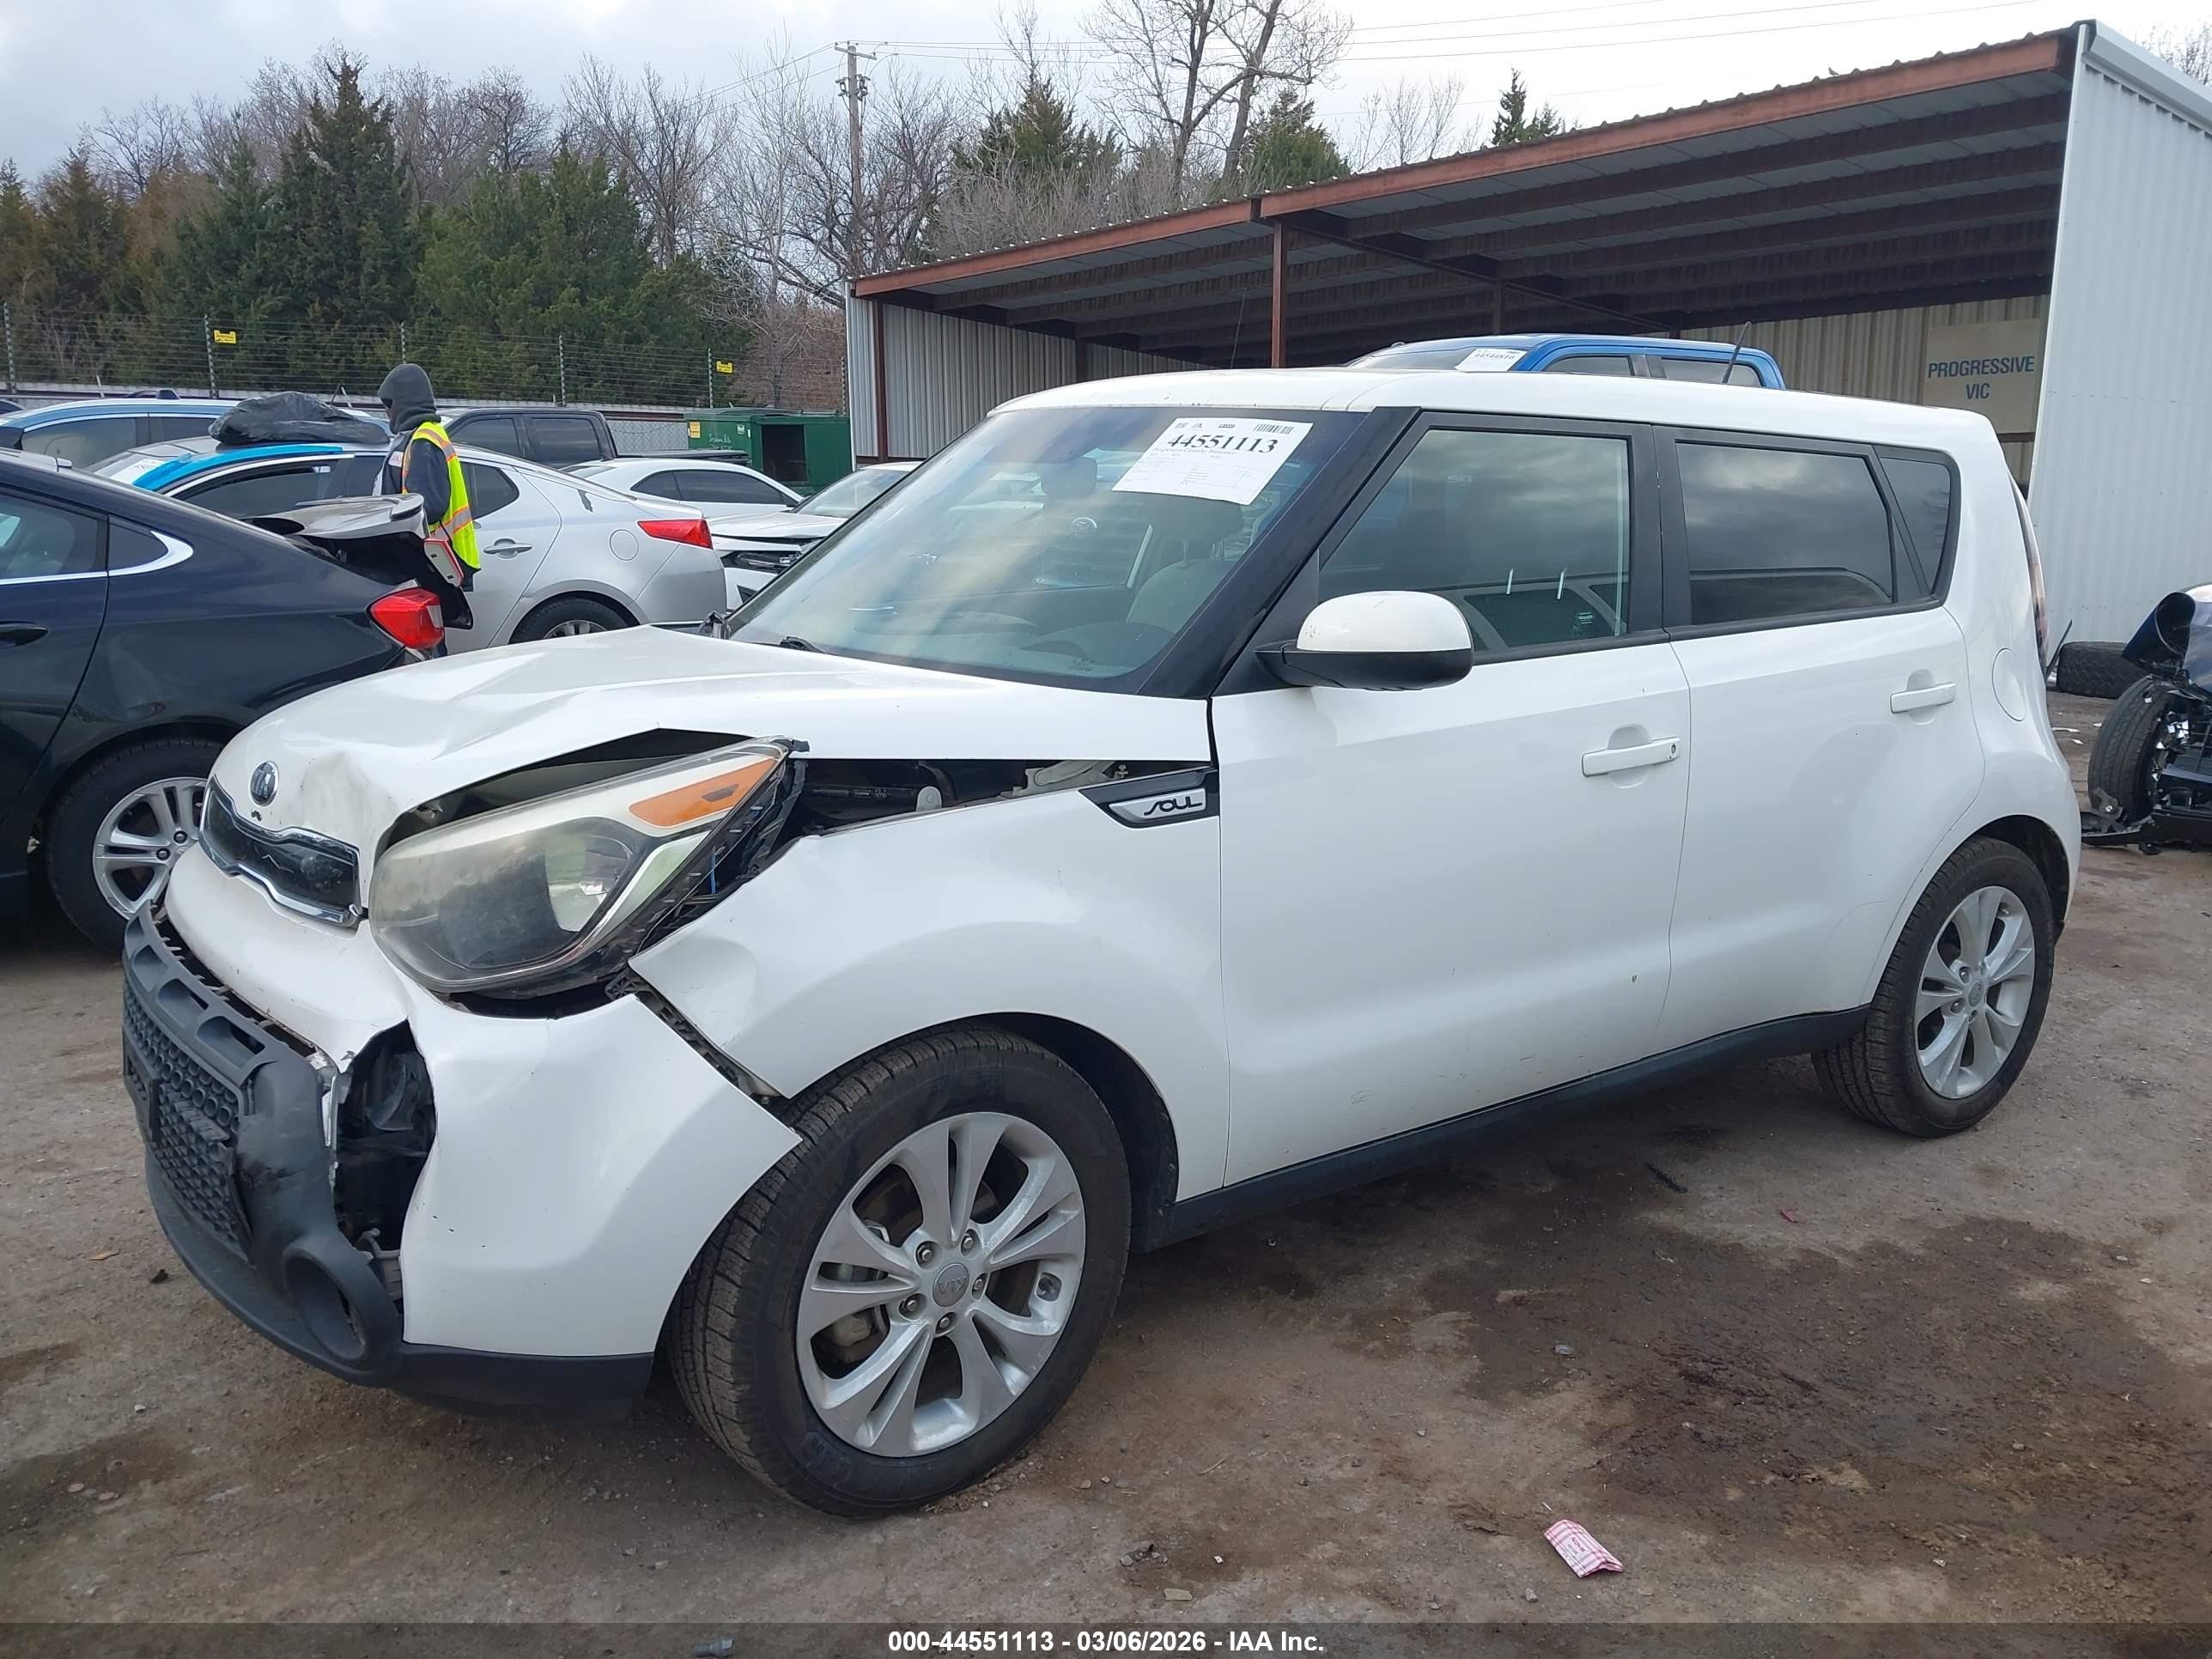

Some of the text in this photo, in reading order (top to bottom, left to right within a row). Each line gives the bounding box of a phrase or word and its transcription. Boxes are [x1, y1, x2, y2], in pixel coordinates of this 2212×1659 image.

[1928, 356, 2034, 378] PROGRESSIVE
[1966, 383, 1990, 399] VIC
[1167, 434, 1279, 453] 44551113
[1143, 796, 1202, 816] SOUL
